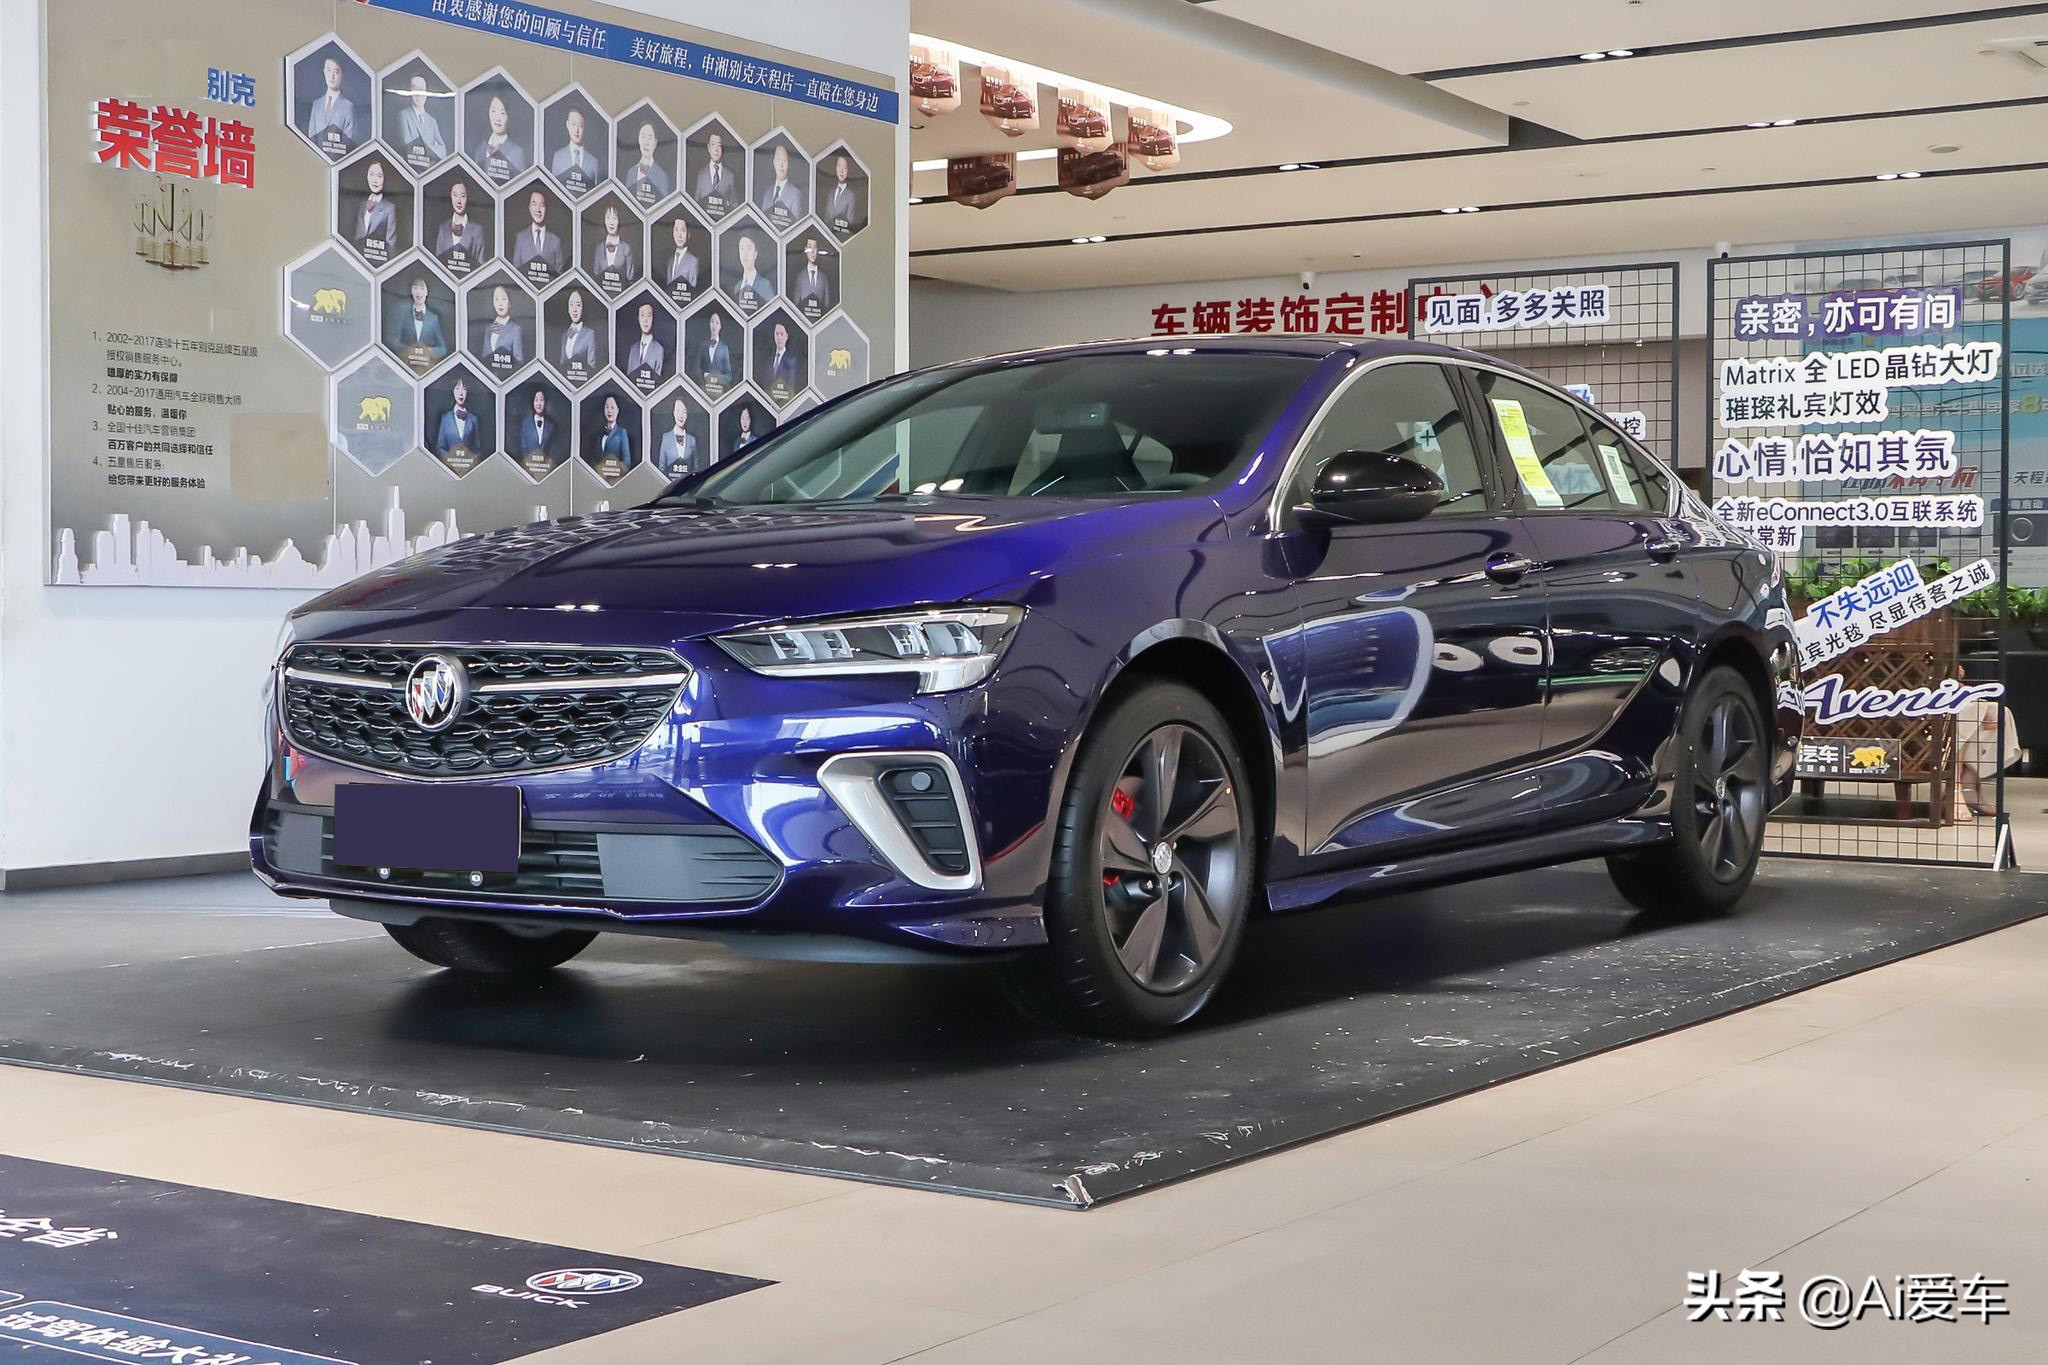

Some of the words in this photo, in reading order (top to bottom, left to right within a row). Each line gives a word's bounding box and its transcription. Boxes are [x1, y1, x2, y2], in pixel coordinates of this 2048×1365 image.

[431, 0, 607, 51] 由衷感谢您的回顾与信任
[207, 67, 256, 107] 别克
[96, 98, 256, 189] 荣誉墙
[1151, 283, 1493, 336] 车辆装饰定制
[1726, 364, 1796, 386] Matrix
[1804, 358, 1828, 384] 全
[1837, 358, 1881, 380] LED
[1885, 348, 1994, 380] 晶钻大灯
[1726, 390, 1882, 422] 璀璨礼宾灯效
[1612, 417, 1641, 436] 控
[2013, 470, 2048, 486] 天程
[1717, 500, 1978, 523] 全新eConnect3.0互联系统
[1811, 563, 1919, 629] 不失远迎
[1804, 677, 2003, 721] Avenir
[471, 1284, 590, 1309] BUICK
[0, 1311, 282, 1365] 试驾体验大
